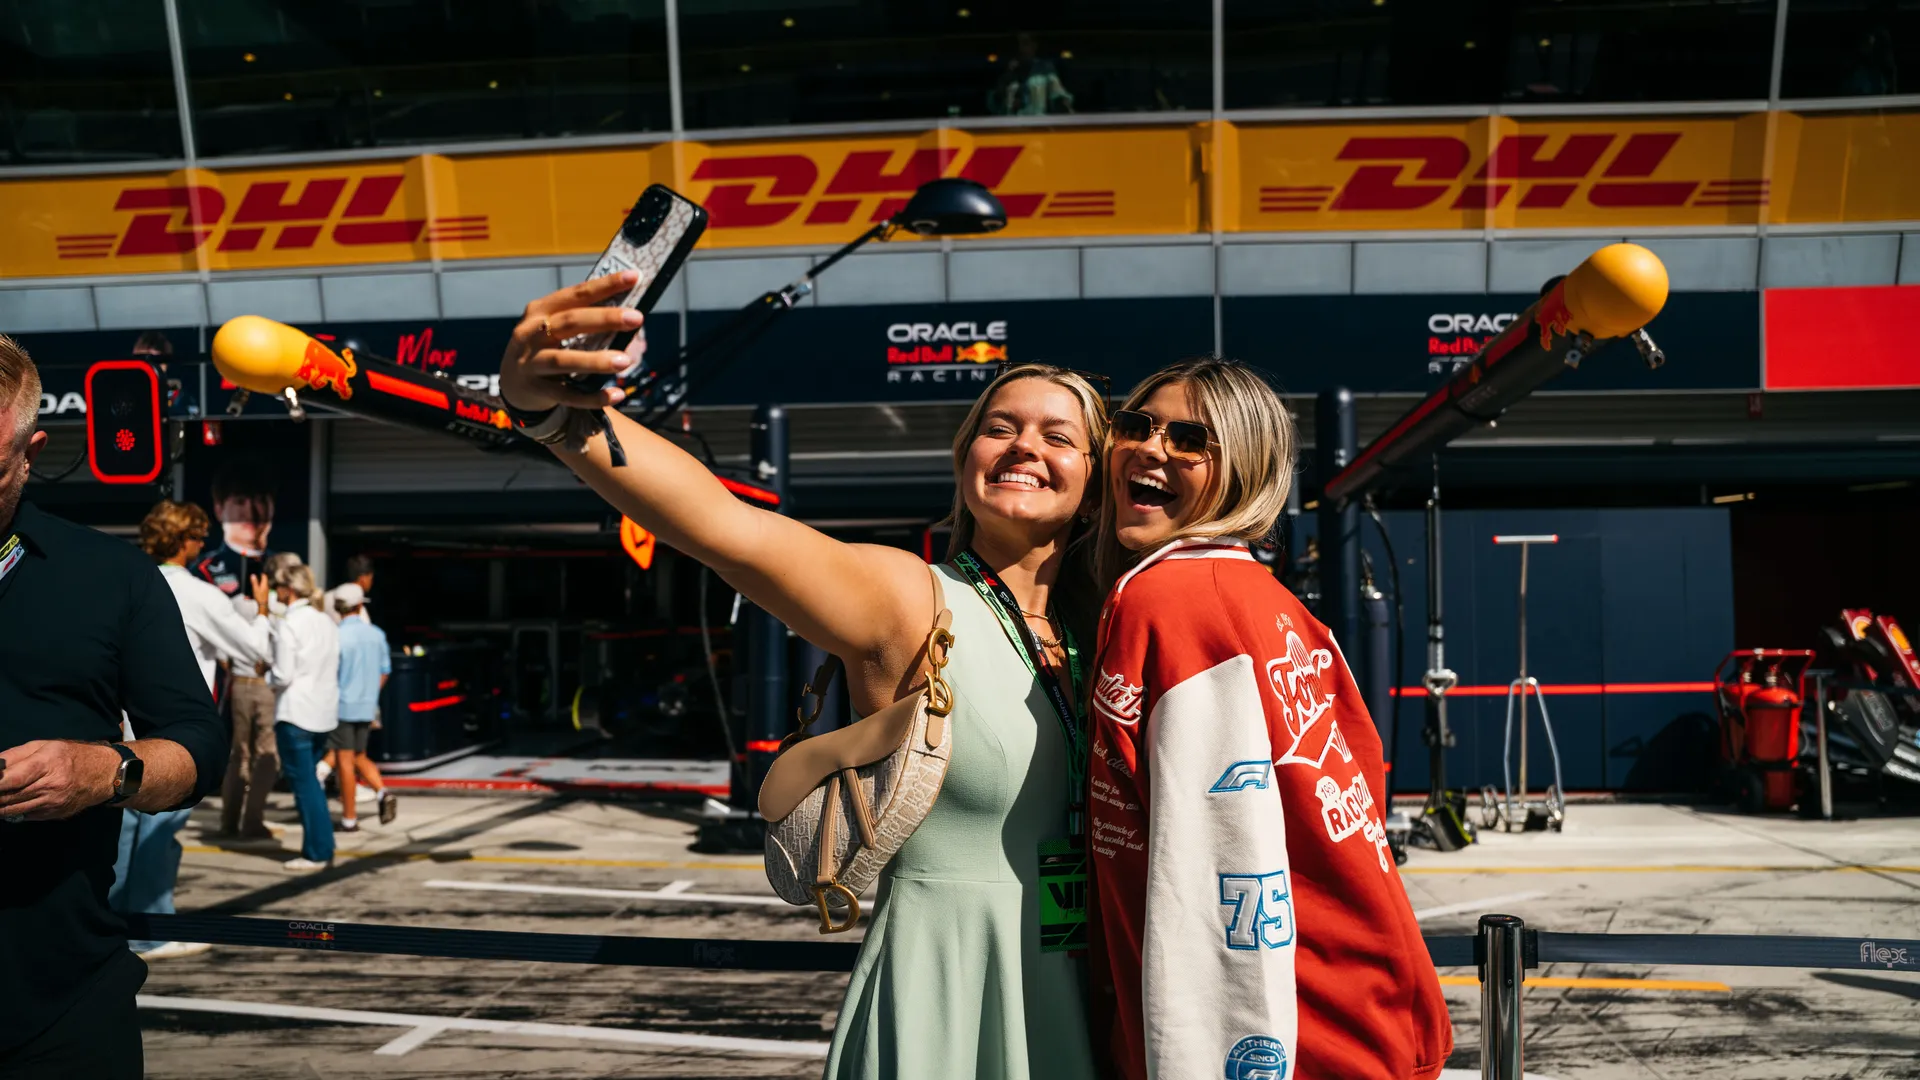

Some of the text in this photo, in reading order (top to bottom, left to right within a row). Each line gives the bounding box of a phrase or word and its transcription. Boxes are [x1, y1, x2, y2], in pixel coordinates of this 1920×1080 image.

[692, 145, 1047, 228] DHL
[1329, 132, 1701, 211] DHL
[114, 174, 427, 257] DHL
[887, 320, 1008, 343] ORACLE
[1428, 313, 1519, 333] ORAC
[396, 327, 457, 372] Max
[887, 370, 986, 383] RACIN
[288, 921, 335, 932] ORACLE
[1219, 870, 1294, 950] 75
[1250, 1053, 1276, 1062] SINCE
